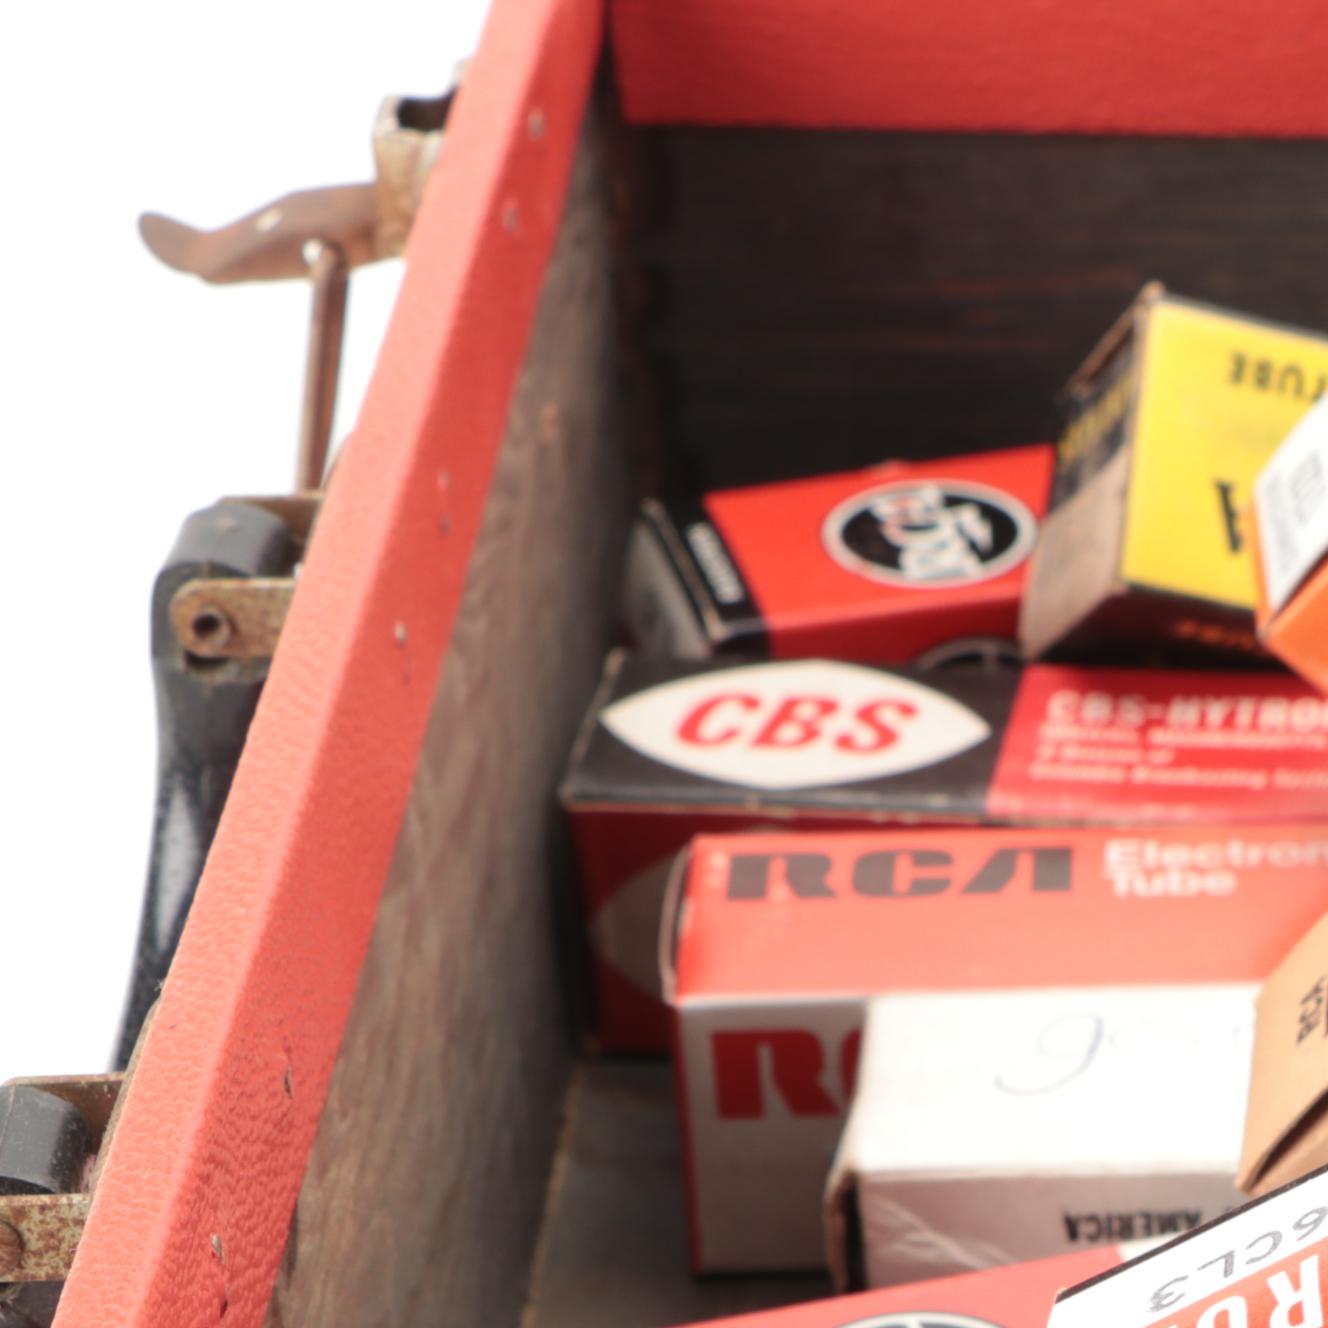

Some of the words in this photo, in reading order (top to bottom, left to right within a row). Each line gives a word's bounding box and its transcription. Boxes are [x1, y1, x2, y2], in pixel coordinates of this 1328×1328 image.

[675, 692, 918, 755] CBS
[726, 847, 1074, 901] RCA
[1104, 870, 1238, 900] Tube
[1062, 1201, 1202, 1242] AMERICA
